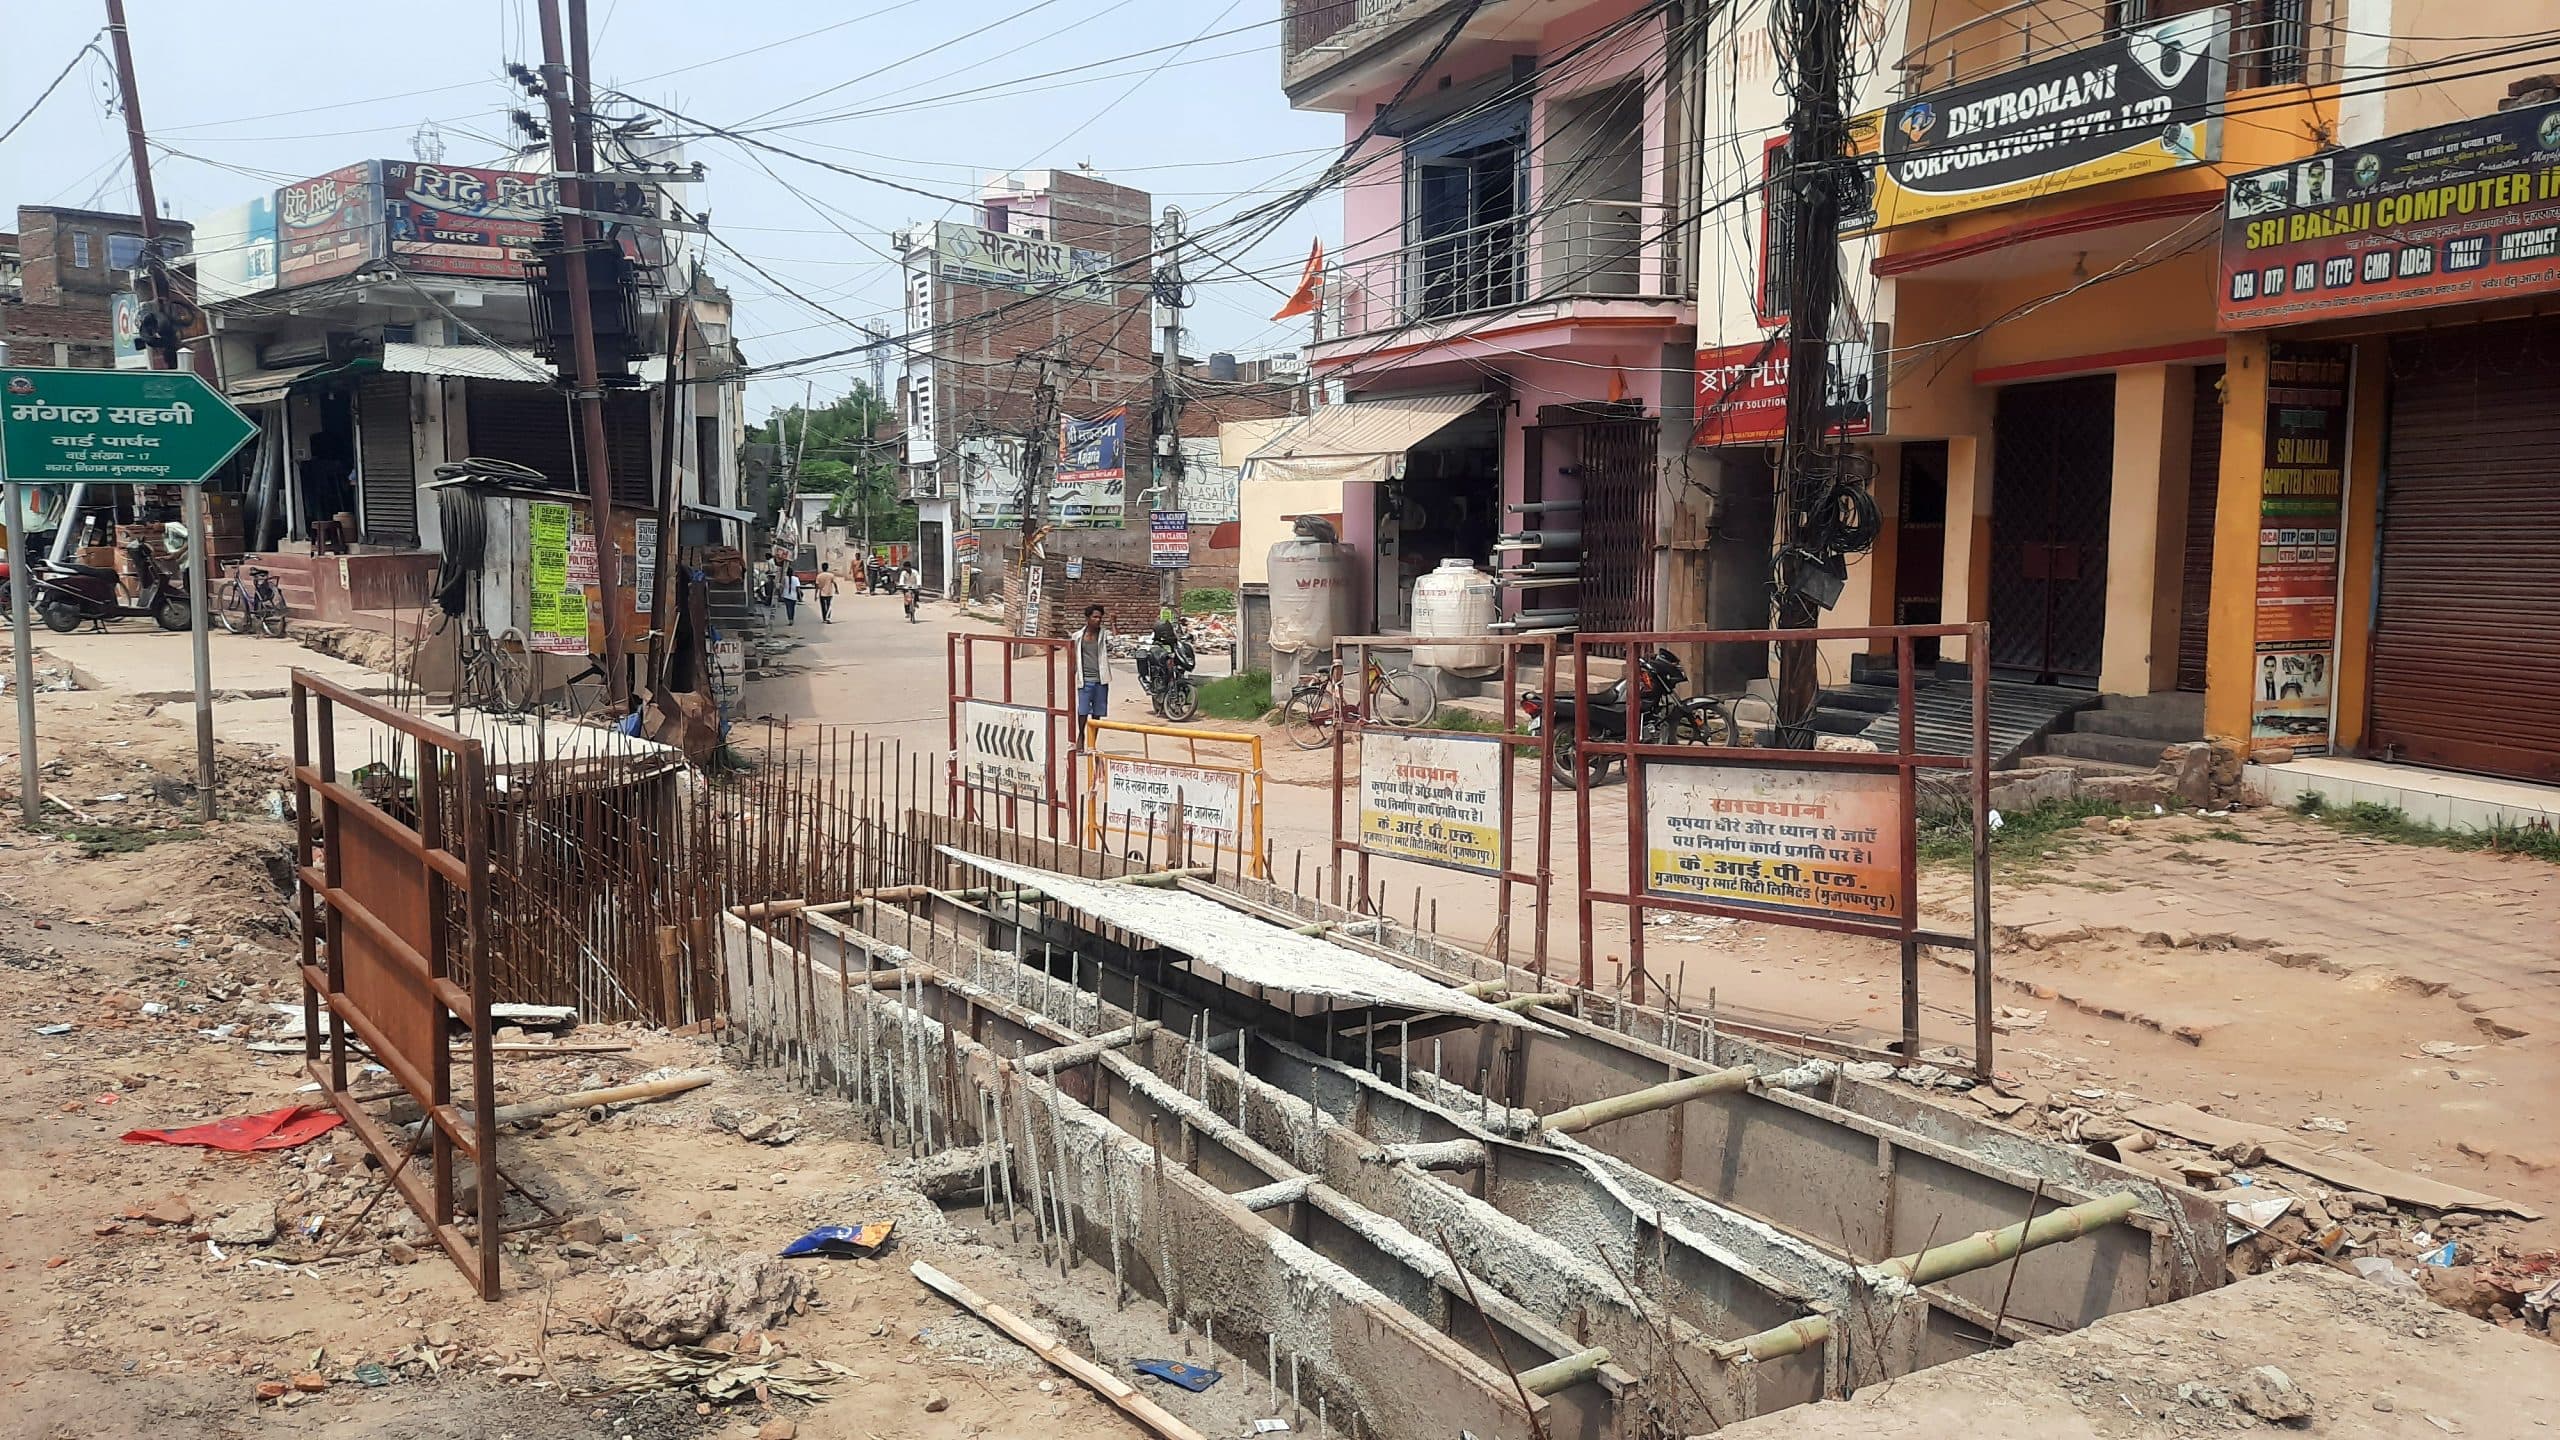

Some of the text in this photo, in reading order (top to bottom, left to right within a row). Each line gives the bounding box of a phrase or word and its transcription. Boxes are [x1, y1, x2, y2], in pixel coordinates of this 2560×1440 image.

[1947, 63, 2118, 139] DETROMANI
[1901, 123, 2057, 183] CORPORATION
[2122, 95, 2173, 130] LTD
[2406, 176, 2438, 189] Computer
[2246, 217, 2285, 250] SRI
[2290, 201, 2371, 242] BALAJI
[2376, 172, 2532, 228] COMPUTER
[432, 230, 480, 242] चादर
[2233, 227, 2558, 299] DCA DTP DFA CTTC CMR ADCA TALLY INTERNET
[10, 399, 195, 426] मंगल सहनी
[51, 433, 161, 447] वार्ड पार्षद
[2277, 438, 2294, 463] SRI
[65, 449, 87, 460] वार्ड
[90, 449, 124, 460] संख्या
[139, 452, 150, 460] 17
[45, 463, 73, 473] नगर
[75, 462, 108, 473] निगम
[2262, 531, 2278, 542] DCA
[2281, 531, 2297, 543] DTP
[1029, 567, 1041, 603] KUMAR
[1395, 764, 1460, 783] सावधान
[1371, 781, 1397, 795] कृपया
[1374, 798, 1387, 809] पथ
[1388, 797, 1416, 815] निर्माण
[1458, 808, 1470, 821] पर
[1709, 798, 1827, 819] सावधान
[1667, 816, 1711, 832] कृपया
[1715, 816, 1740, 834] धीरे
[1745, 818, 1775, 836] और
[1780, 823, 1818, 840] ध्यान
[1823, 825, 1837, 841] से
[1673, 834, 1696, 847] पथ
[1697, 834, 1746, 853] निर्माण
[1750, 841, 1781, 857] कार्य
[1785, 844, 1825, 860] प्रगति
[1830, 848, 1849, 863] पर
[1655, 872, 1710, 891] मुजफ्फरपुर
[1712, 876, 1738, 892] स्मार्ट
[1741, 878, 1765, 895] सिटी
